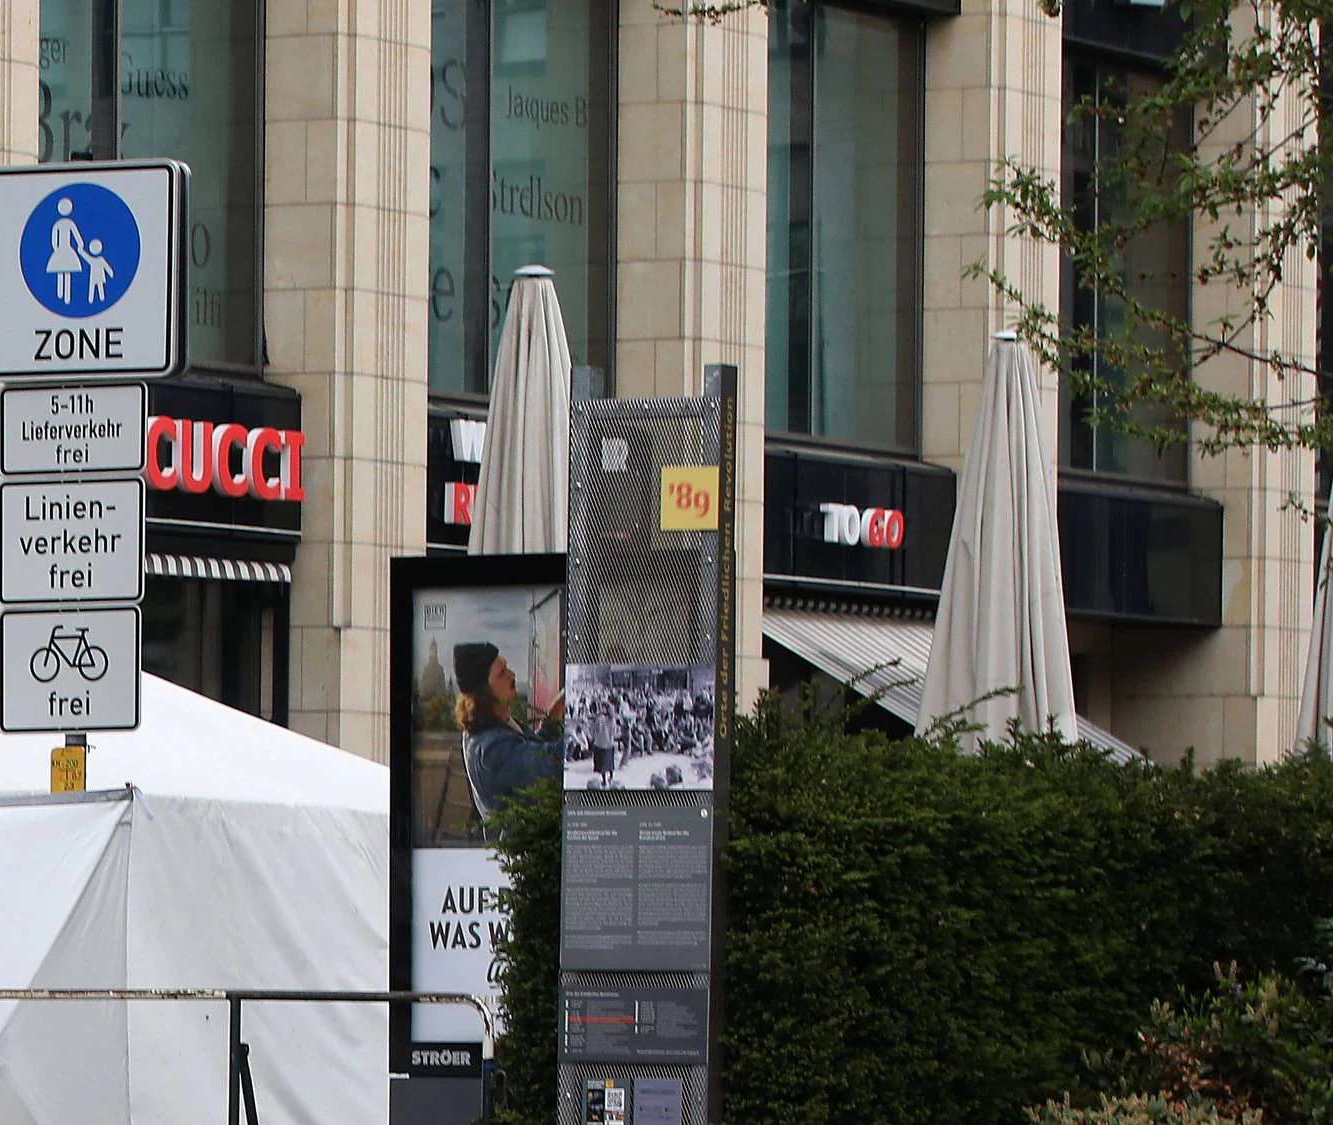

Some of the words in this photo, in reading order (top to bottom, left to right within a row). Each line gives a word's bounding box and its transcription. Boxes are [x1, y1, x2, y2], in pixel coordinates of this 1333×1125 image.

[507, 85, 568, 129] Jacques
[34, 327, 124, 361] ZONE
[51, 394, 94, 415] 5-11h
[22, 419, 123, 441] Lieferverkehr
[55, 443, 89, 464] frei
[147, 415, 306, 502] CUCCI
[723, 397, 734, 513] Revolution
[25, 494, 116, 521] Linien-
[820, 502, 860, 547] TO
[860, 507, 905, 548] GO
[20, 528, 122, 555] verkehr
[49, 562, 93, 589] frei
[720, 522, 732, 642] Friedlichen
[719, 648, 729, 685] der
[48, 691, 92, 717] frei
[718, 693, 729, 739] Orte
[441, 886, 490, 914] AUF
[429, 920, 481, 950] WAS
[411, 1049, 471, 1067] STRÖER
